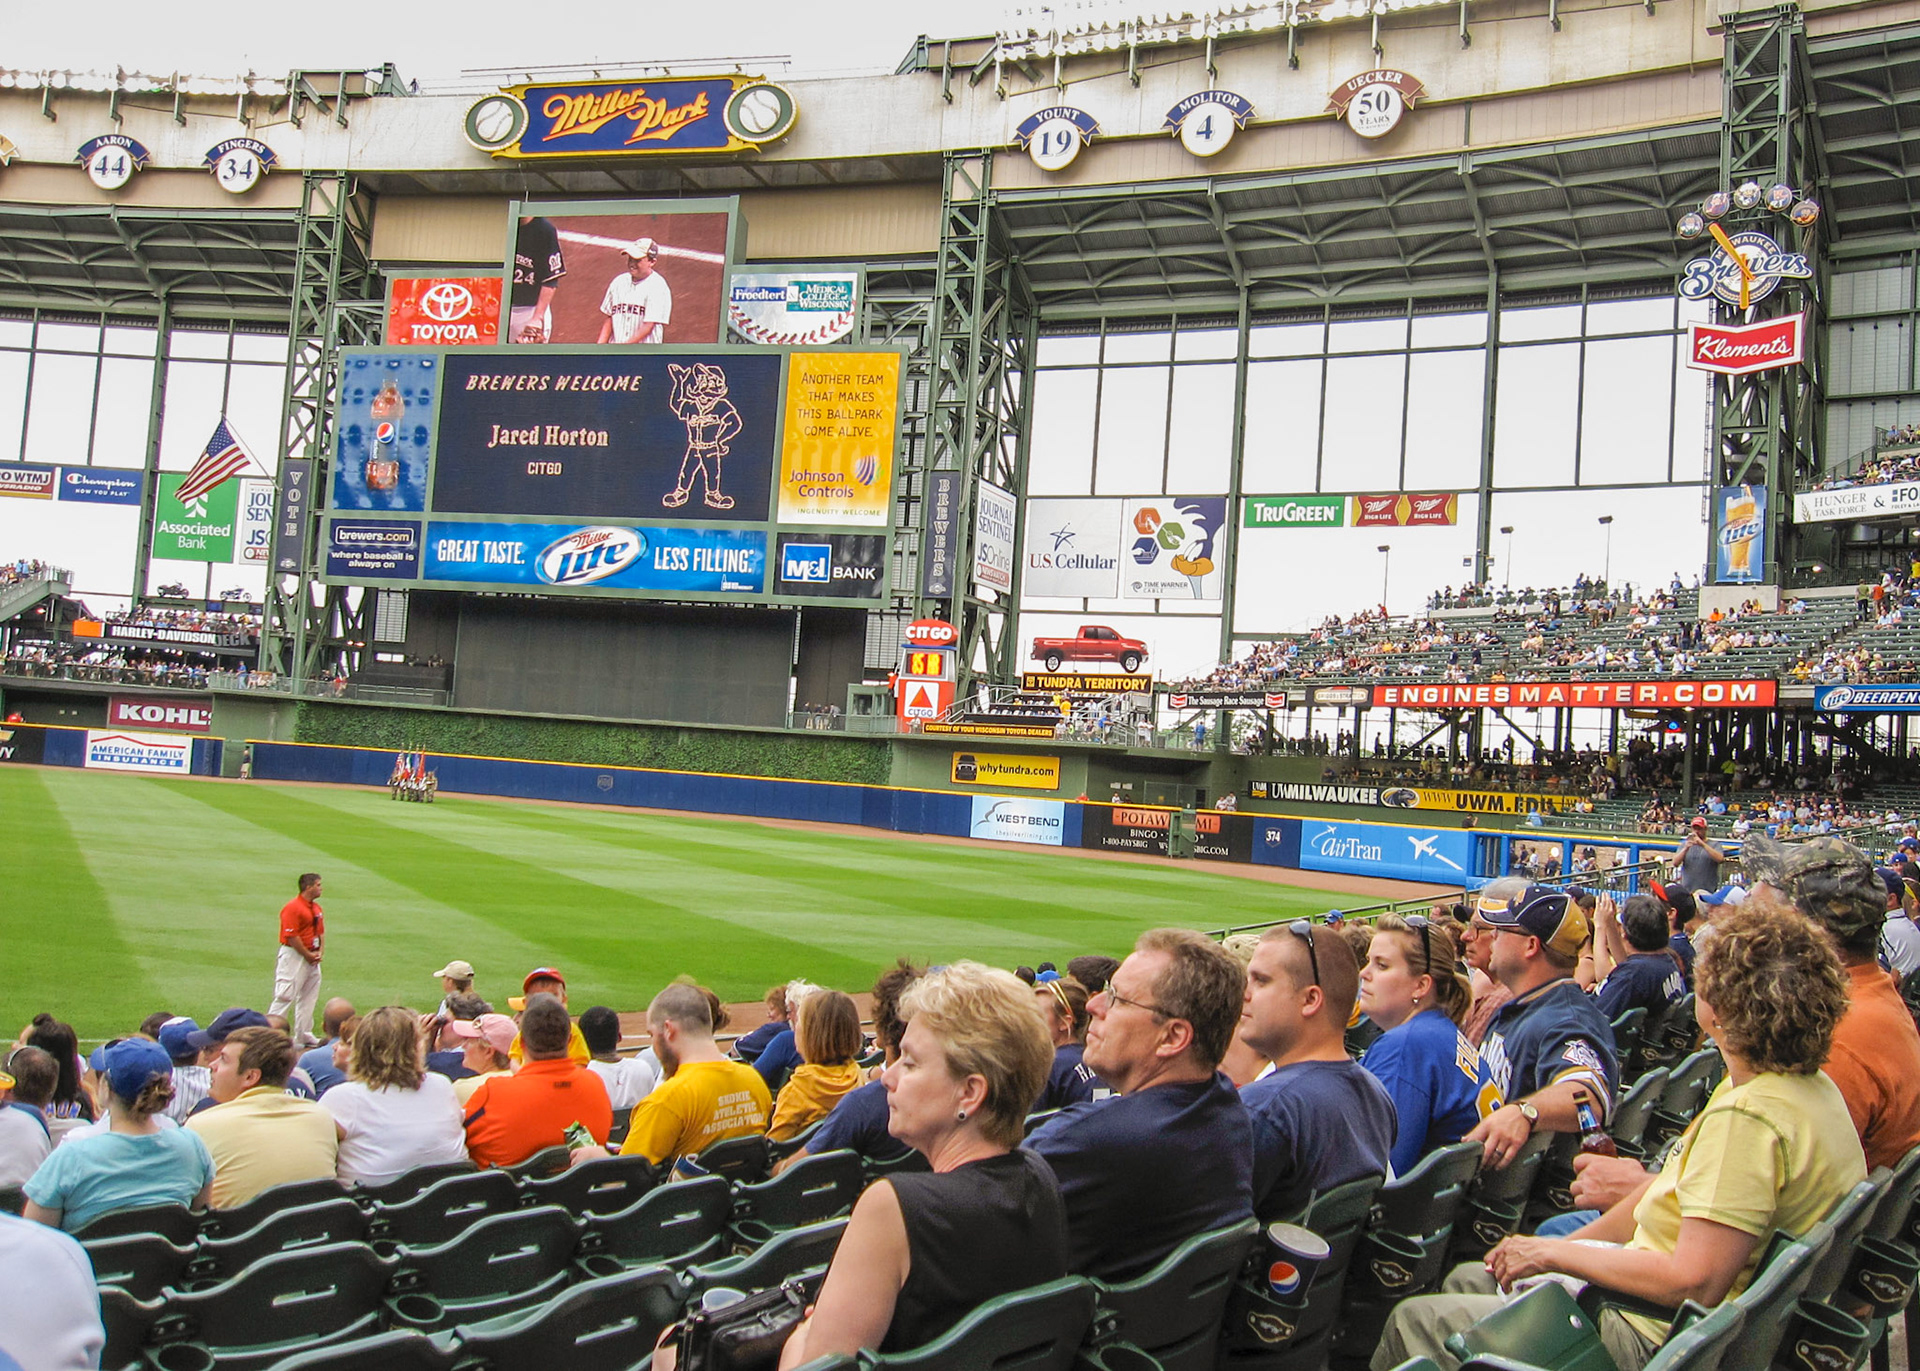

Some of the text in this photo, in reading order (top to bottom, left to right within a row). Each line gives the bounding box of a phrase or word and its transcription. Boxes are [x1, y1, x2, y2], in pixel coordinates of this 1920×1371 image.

[1346, 71, 1403, 92] UECKER
[1178, 91, 1241, 114] MOLITOR
[1359, 90, 1390, 115] 50
[543, 86, 710, 146] Miller Park
[1034, 107, 1081, 122] YOUNT
[1195, 115, 1213, 141] 4
[96, 136, 134, 148] AARON
[217, 140, 266, 156] FINGERS
[1037, 130, 1073, 158] 19
[94, 154, 126, 177] 44
[223, 158, 253, 181] 34
[1680, 258, 1814, 298] Brewers
[735, 288, 786, 300] Froedtert
[798, 290, 840, 302] COLLEGE
[805, 283, 847, 295] MEDICAL
[799, 300, 849, 310] WISCONSIN
[410, 324, 479, 340] TOYOTA
[1697, 335, 1793, 361] Klement's
[465, 374, 643, 392] BREWERS WELCOME
[800, 373, 884, 385] ANOTHER TEAM
[809, 391, 875, 402] THAT MAKES
[797, 409, 883, 420] THIS BALLPARK
[487, 424, 609, 449] Jared Horton
[804, 426, 833, 437] COME
[526, 461, 563, 475] CITGO
[14, 473, 49, 484] WTMJ
[66, 473, 136, 490] Champion
[789, 469, 844, 483] Johnson
[798, 485, 854, 498] Controls
[285, 471, 303, 537] VOTE
[1364, 499, 1393, 513] Miller
[1413, 498, 1443, 512] Miller
[1814, 493, 1866, 507] HUNGER
[1873, 495, 1885, 508] &
[979, 497, 1013, 527] JOURNAL
[1815, 504, 1867, 517] TASK FORCE
[158, 520, 231, 537] Associated
[933, 479, 950, 577] BREWERS
[978, 515, 1012, 544] SENTINEL
[1724, 522, 1758, 545] Lite
[178, 536, 207, 550] Bank
[338, 529, 410, 543] brewers.com
[570, 532, 613, 551] Miller
[331, 551, 361, 560] where
[363, 551, 403, 561] baseball
[437, 539, 525, 565] GREAT TASTE.
[654, 546, 688, 571] LESS
[348, 560, 382, 569] always
[553, 541, 630, 584] Lite
[1030, 554, 1117, 569] U.S. Cellular
[833, 566, 876, 581] BANK
[112, 626, 215, 644] HARLEY-DAVIDSON
[905, 626, 953, 640] CITGO
[1037, 677, 1147, 690] TUNDRA TERRITORY
[1188, 696, 1198, 705] The
[1199, 696, 1223, 706] Sausage
[1224, 696, 1238, 705] Race
[1239, 696, 1264, 706] Sausage
[1853, 692, 1915, 703] BEERPEN
[908, 709, 933, 717] CITGO
[925, 725, 952, 733] COURTESY
[92, 745, 184, 758] AMERICAN FAMILY
[97, 755, 177, 767] INSURANCE
[979, 762, 1054, 778] whytundra.com
[996, 814, 1059, 827] WEST BEND
[1130, 829, 1158, 839] BINGO
[1265, 832, 1281, 842] 374
[1102, 838, 1148, 848] 1-800-PAYSBIG
[713, 1102, 757, 1121] ATHLETIC
[702, 1113, 764, 1135] ASSOCIATION
